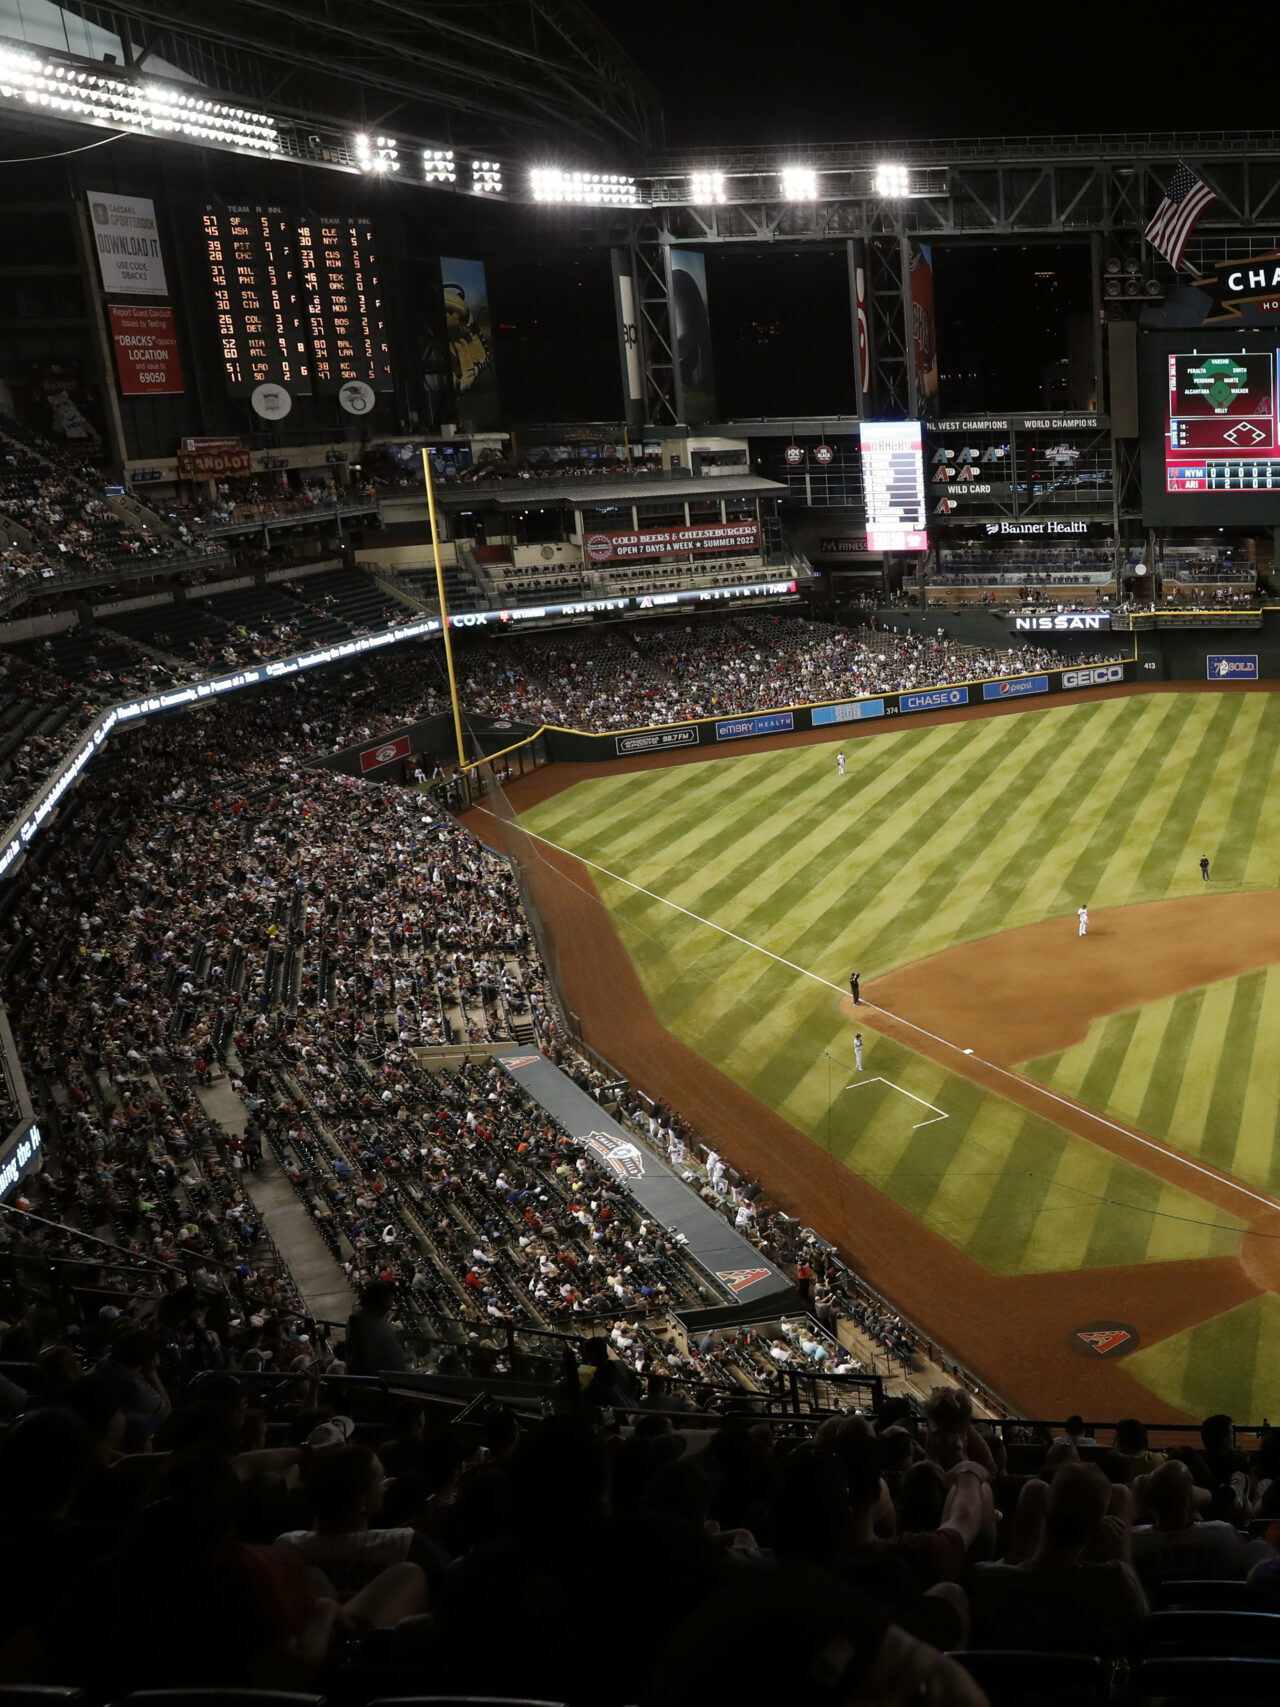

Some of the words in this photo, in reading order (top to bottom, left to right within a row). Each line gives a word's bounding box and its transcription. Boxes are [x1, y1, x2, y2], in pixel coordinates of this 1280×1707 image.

[110, 214, 155, 230] SPORTSBOOK
[97, 234, 149, 257] DOWNLOAD
[149, 239, 159, 258] IT
[117, 262, 129, 271] USE
[122, 271, 148, 280] DBACKS
[129, 350, 168, 360] LOCATION
[140, 372, 165, 383] 69050
[939, 421, 960, 430] WEST
[962, 421, 1007, 430] CHAMPIONS
[1024, 420, 1050, 428] WORLD
[1052, 419, 1097, 428] CHAMPIONS
[948, 485, 966, 494] WILD
[969, 484, 991, 494] CARD
[1001, 523, 1046, 534] Banner
[1047, 521, 1087, 534] Health
[612, 535, 638, 545] COLD
[640, 533, 670, 542] BEERS
[672, 532, 677, 540] &
[679, 526, 757, 539] CHEESEBURGERS
[617, 545, 638, 555] OPEN
[639, 545, 644, 553] 7
[646, 543, 665, 553] DAYS
[666, 543, 671, 551] A
[672, 541, 693, 550] WEEK
[704, 538, 735, 547] SUMMER
[737, 536, 754, 545] 2022
[453, 614, 487, 627] COX
[1016, 618, 1100, 630] NISSAN
[1063, 666, 1123, 687] GEICO
[1010, 680, 1032, 693] pepsi
[908, 693, 948, 708] CHASE
[886, 707, 898, 715] 374
[758, 718, 791, 728] HEALTH
[663, 733, 677, 743] 98.7
[678, 732, 689, 741] FM
[595, 1135, 616, 1150] CHASE
[622, 1158, 639, 1174] FIELD
